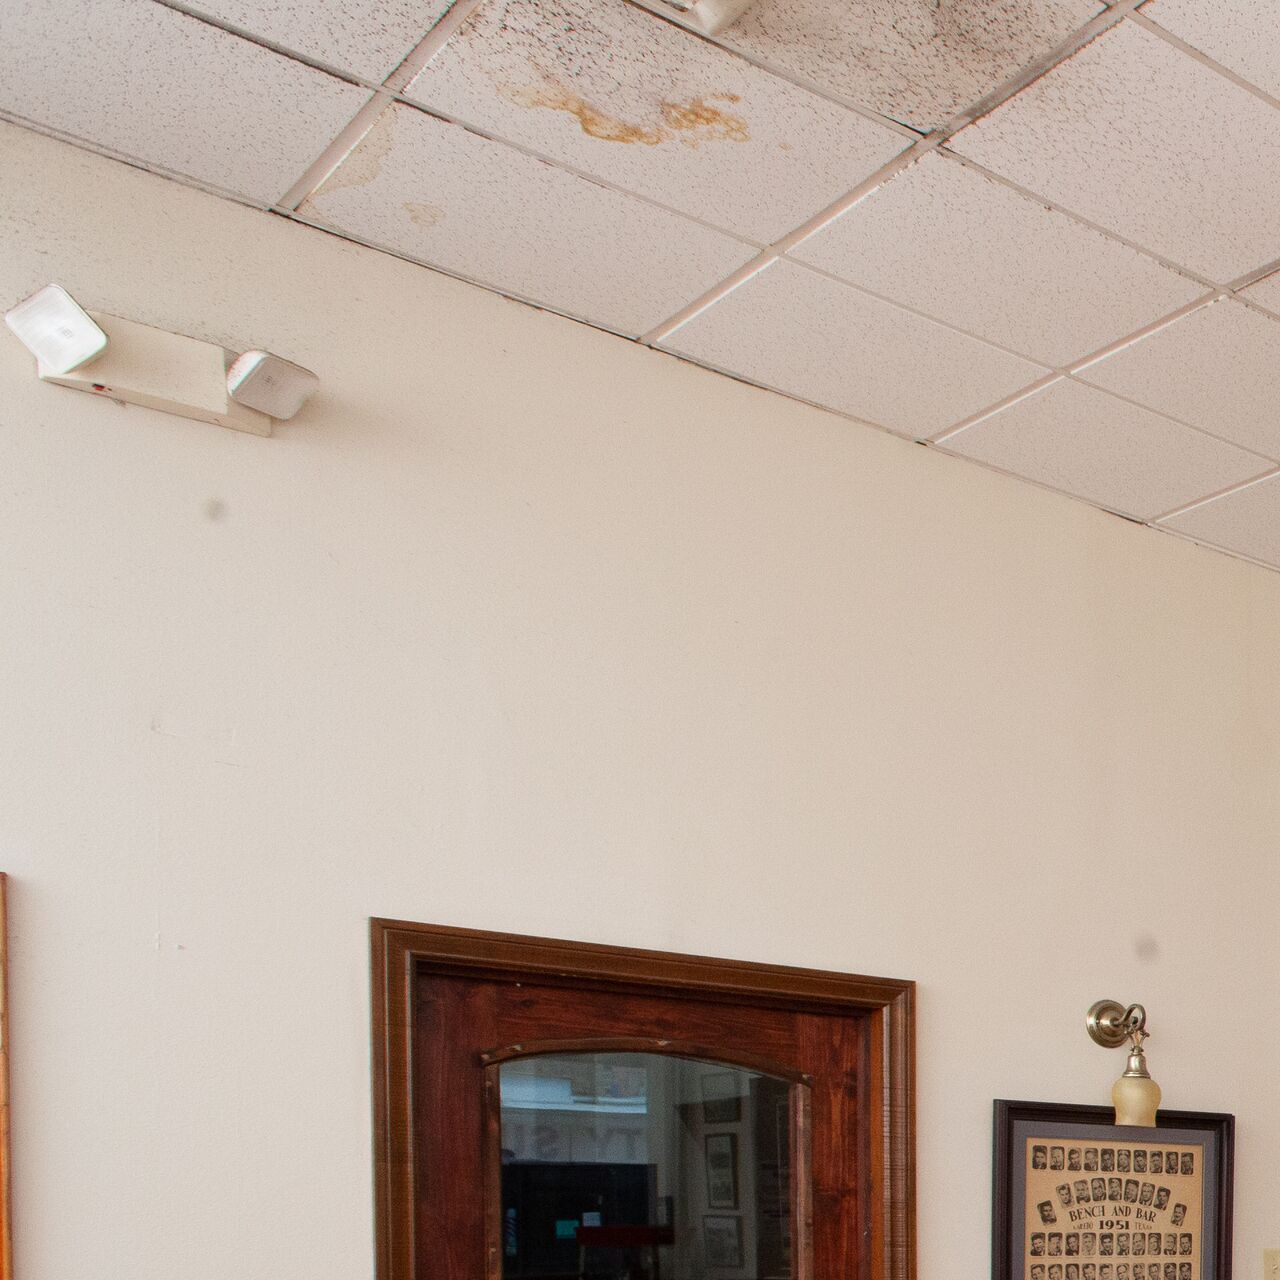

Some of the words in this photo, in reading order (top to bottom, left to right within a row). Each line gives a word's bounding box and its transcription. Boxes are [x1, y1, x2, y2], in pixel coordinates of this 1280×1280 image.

[1069, 1205, 1105, 1221] BENCH
[1111, 1205, 1131, 1217] AND
[1136, 1207, 1156, 1223] BAR
[1099, 1220, 1129, 1230] 1951
